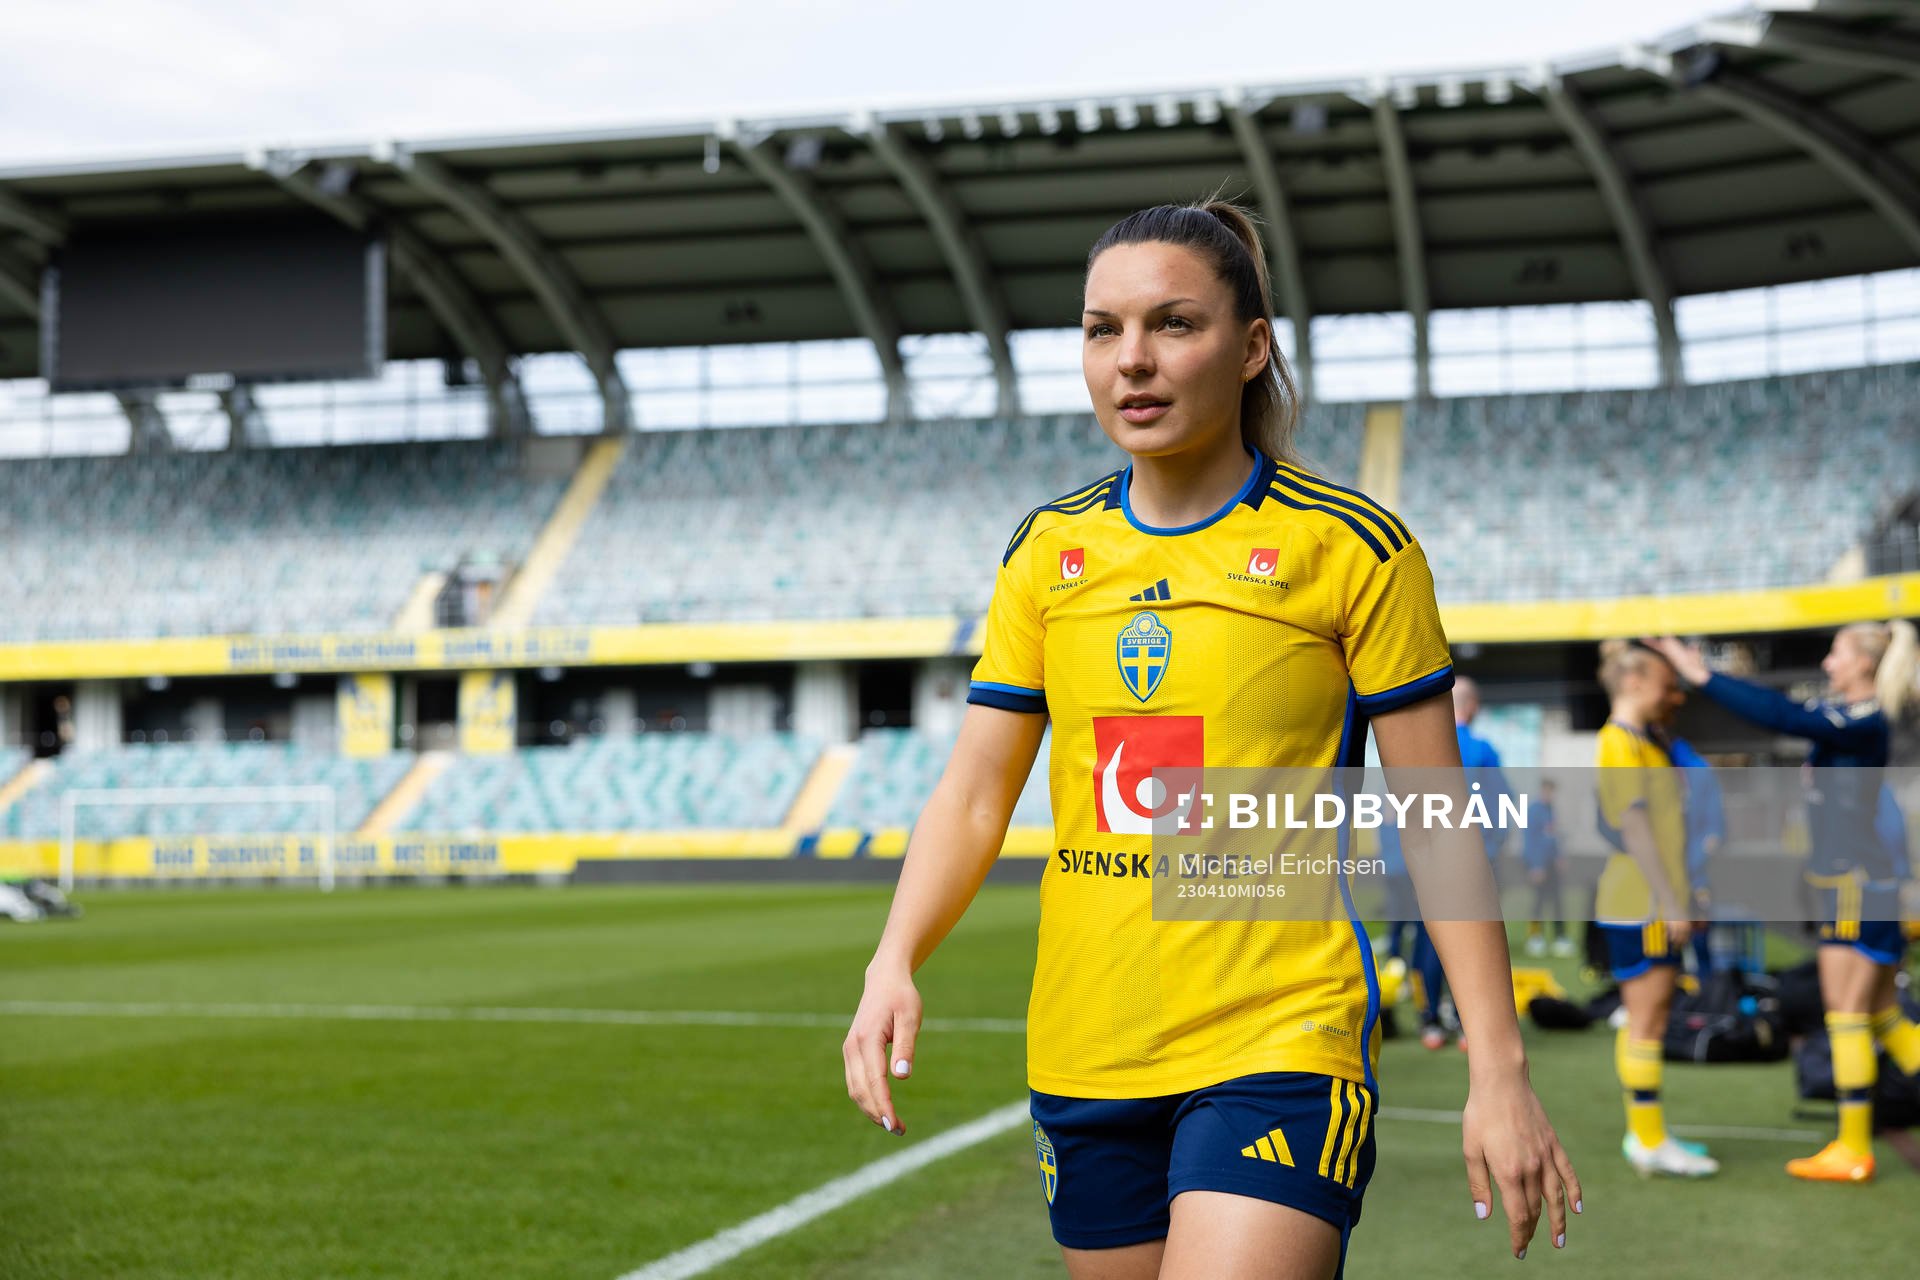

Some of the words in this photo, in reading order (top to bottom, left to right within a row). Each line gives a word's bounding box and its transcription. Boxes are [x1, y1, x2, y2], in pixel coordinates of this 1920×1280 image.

[1227, 572, 1267, 585] SVENSKA
[1049, 581, 1078, 592] SVENSKA
[1127, 637, 1162, 646] SVERIGE
[1057, 848, 1170, 879] SVENSKA
